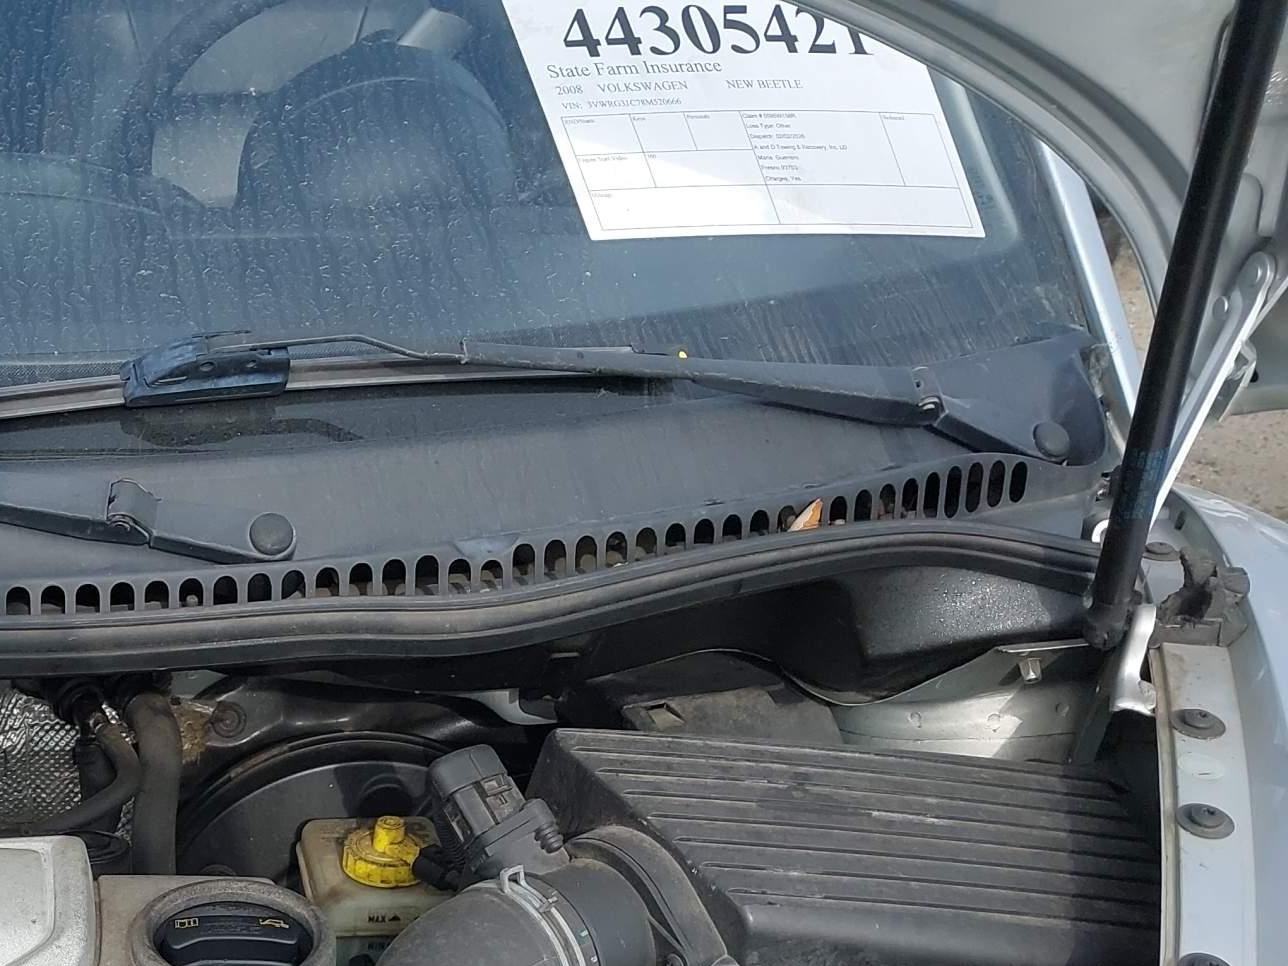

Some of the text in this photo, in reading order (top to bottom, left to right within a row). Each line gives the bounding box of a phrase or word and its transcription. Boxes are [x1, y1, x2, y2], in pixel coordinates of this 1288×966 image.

[563, 4, 874, 57] 44305421
[547, 60, 723, 79] State Farm Insurance
[556, 79, 804, 96] 2008 VOLKSWAGEN NEW BEETLE
[562, 102, 583, 111] VIN:
[368, 912, 387, 923] MAX
